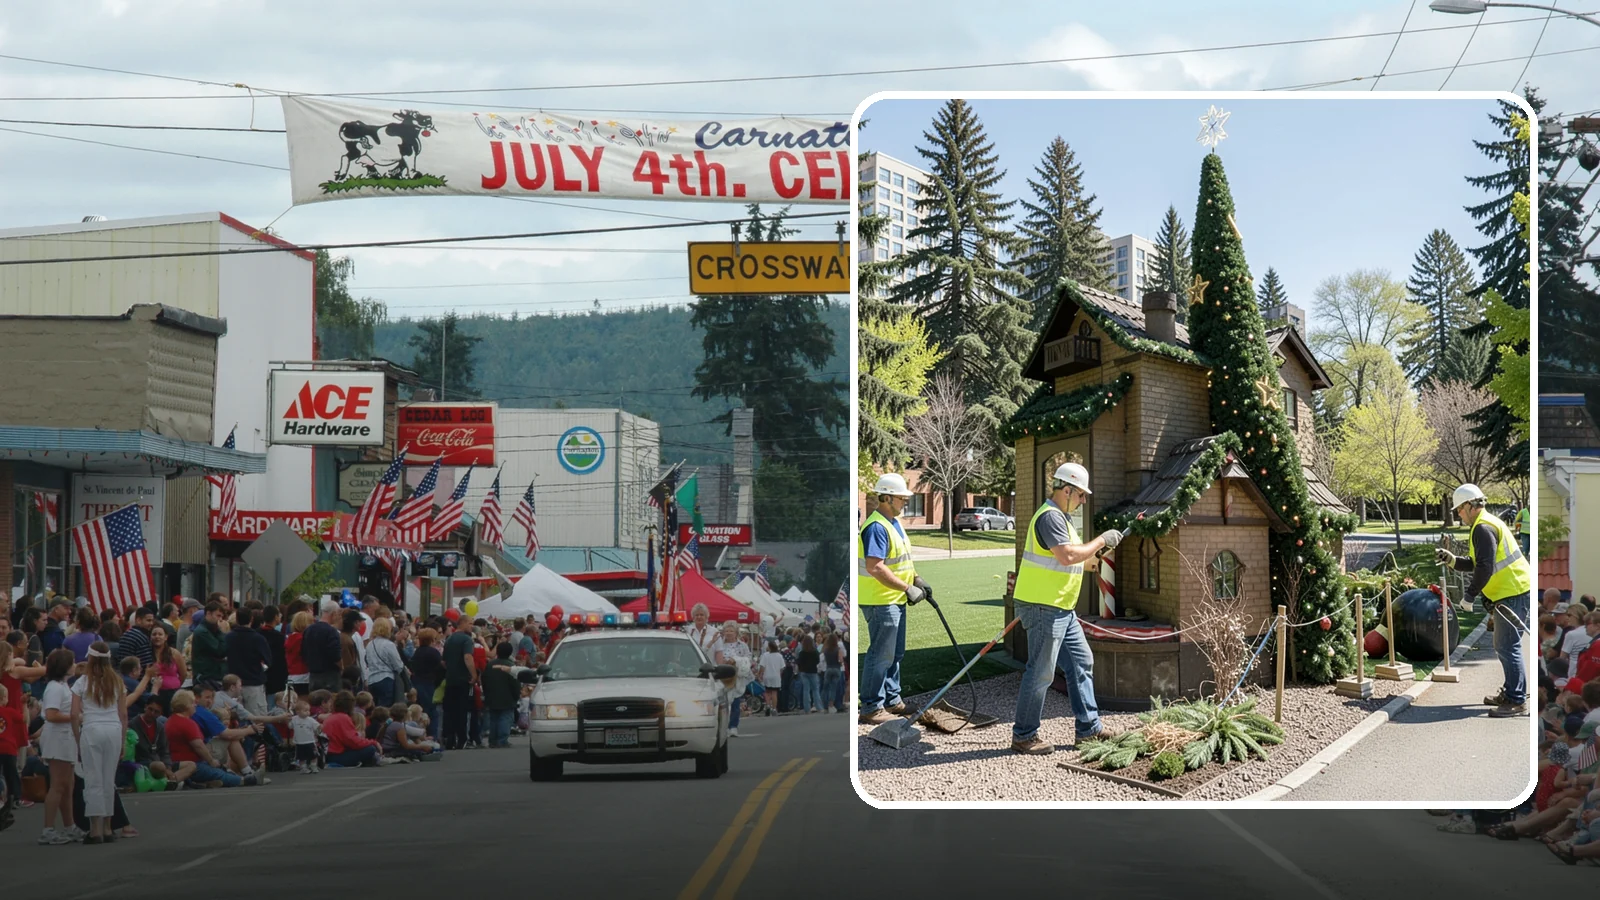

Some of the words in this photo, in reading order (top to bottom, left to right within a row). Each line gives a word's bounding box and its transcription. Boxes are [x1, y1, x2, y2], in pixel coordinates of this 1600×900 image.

[695, 121, 850, 150] Carnat
[481, 141, 605, 193] JULY
[632, 150, 747, 198] 4th.
[697, 254, 850, 280] CROSSWA
[283, 380, 373, 420] ACE
[406, 410, 452, 421] CEDAR
[461, 410, 485, 421] LOG
[284, 421, 371, 436] Hardware
[416, 428, 476, 447] Coca-Cola
[354, 467, 385, 481] Simpl
[96, 485, 124, 495] Vincent
[126, 486, 136, 494] de
[138, 486, 155, 495] Paul
[212, 516, 331, 536] HARDARE
[688, 527, 741, 535] CRNATION
[699, 535, 730, 543] GLASS
